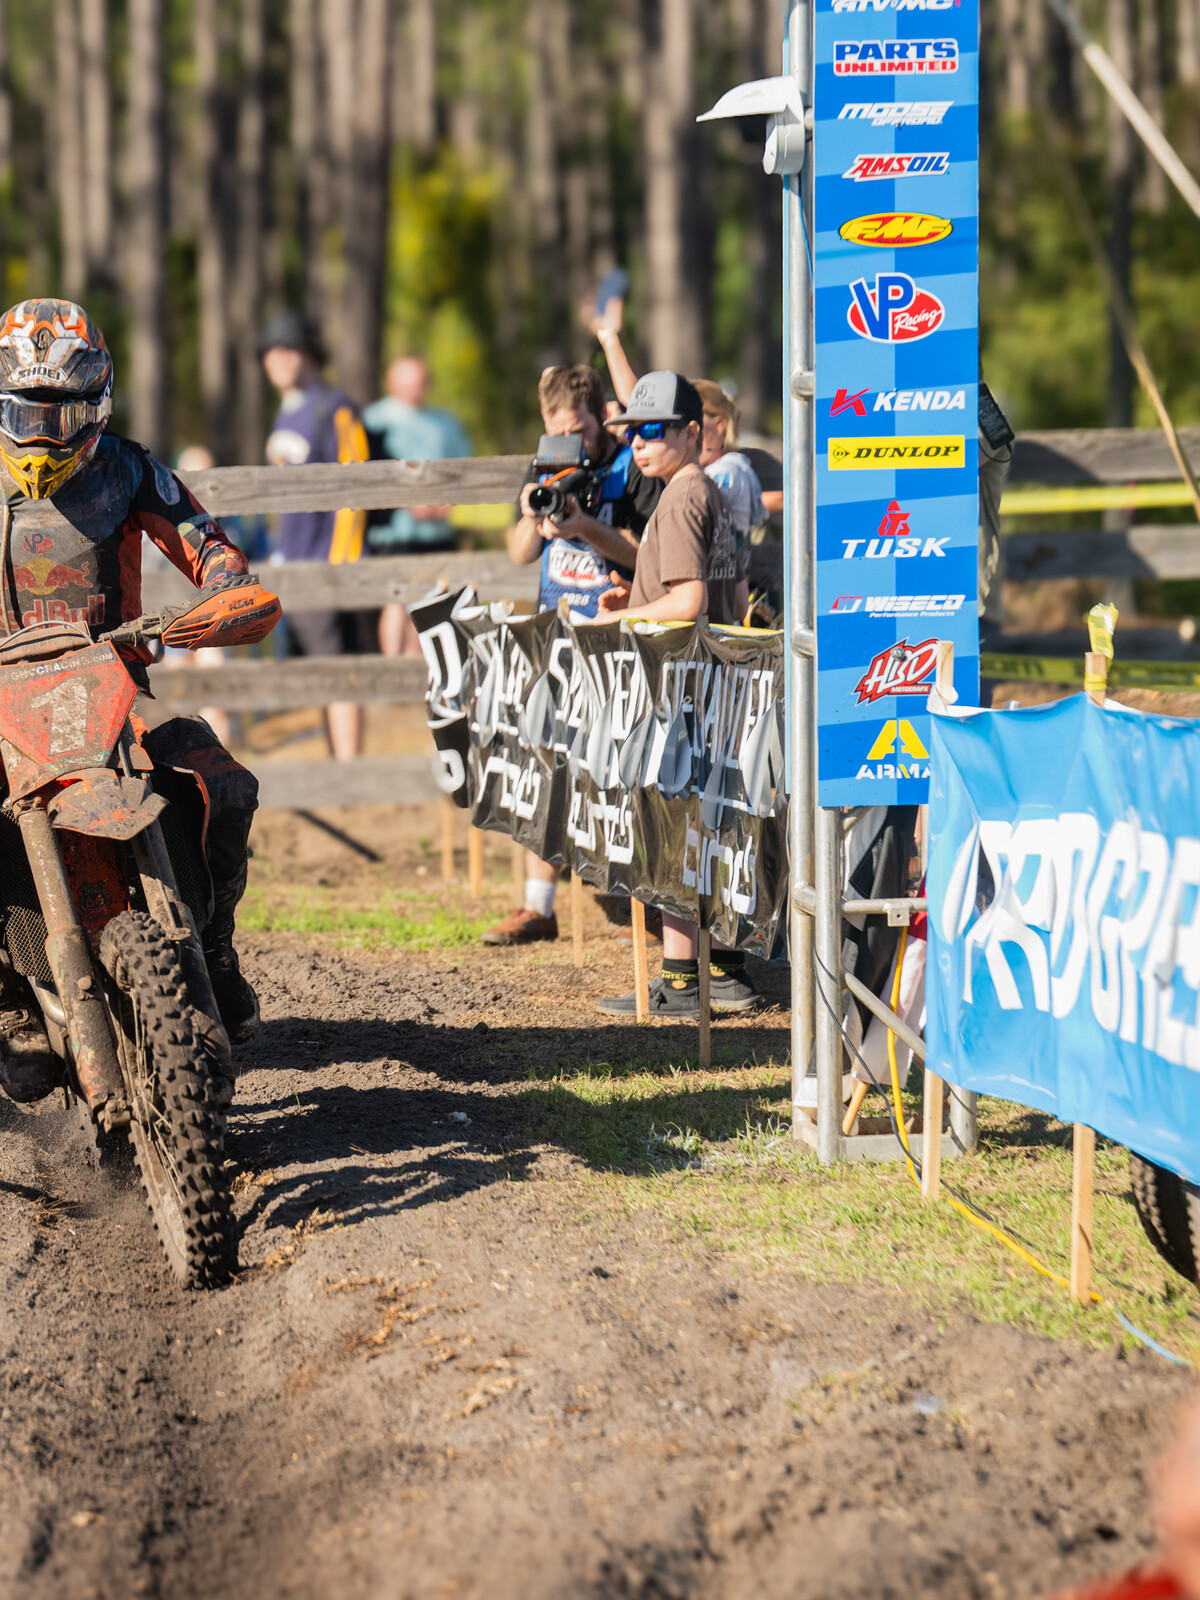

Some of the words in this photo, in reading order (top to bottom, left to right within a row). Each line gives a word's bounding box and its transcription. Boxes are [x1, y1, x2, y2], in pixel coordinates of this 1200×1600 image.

[835, 41, 957, 60] PARTS
[835, 61, 957, 73] UNLIMITED
[837, 101, 954, 120] MOOSE
[850, 156, 946, 178] AMSOIL
[840, 216, 952, 240] FMF
[851, 275, 914, 339] VP
[894, 308, 942, 335] Racing
[18, 366, 61, 380] SHOEI
[873, 389, 966, 412] KENDA
[853, 445, 960, 459] DUNLOP
[842, 537, 952, 559] TUSK
[46, 594, 106, 628] Bull
[228, 598, 254, 611] KTM
[30, 676, 88, 757] 1
